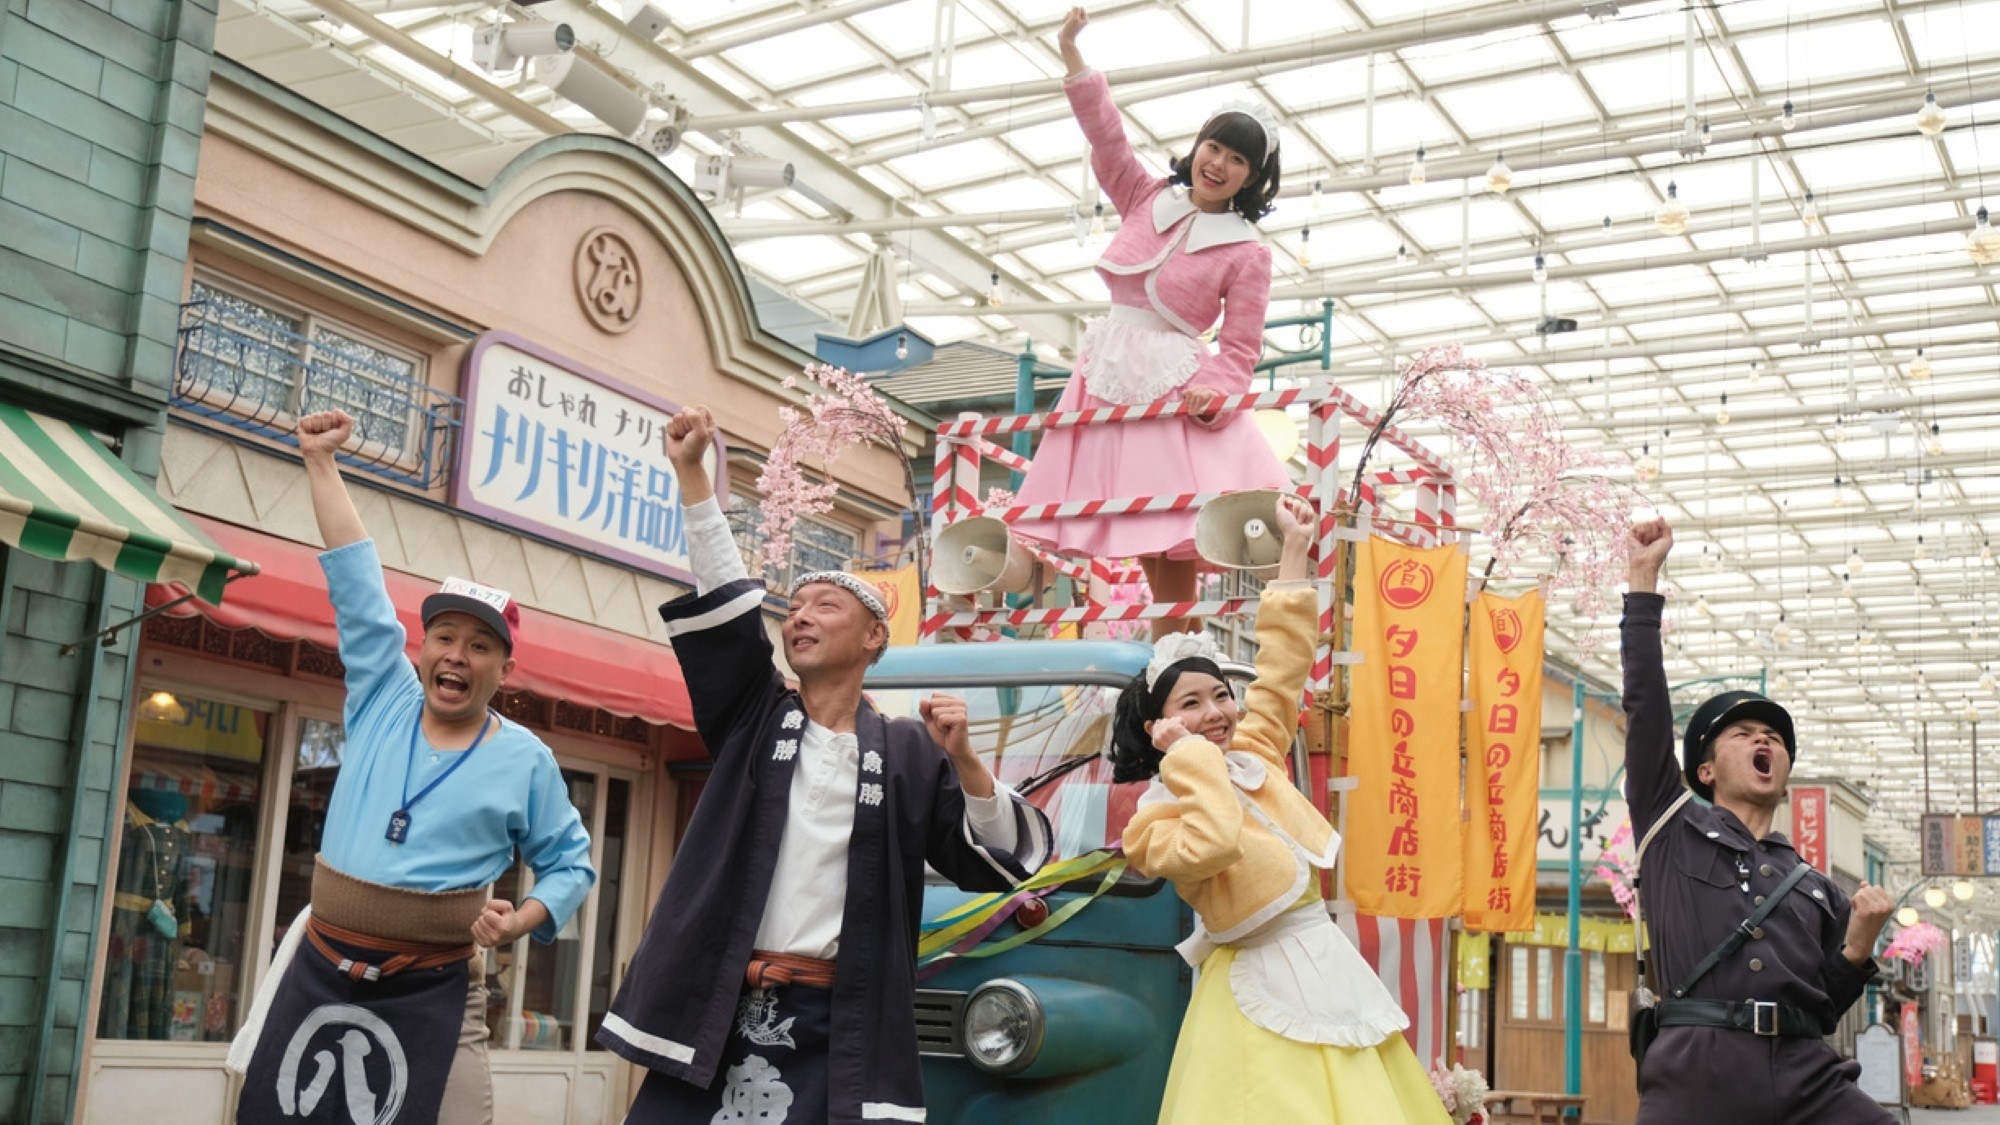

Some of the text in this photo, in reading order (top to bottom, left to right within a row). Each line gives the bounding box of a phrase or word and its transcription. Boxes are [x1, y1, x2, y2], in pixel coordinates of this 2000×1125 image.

[507, 364, 599, 429] おしゃれ
[1384, 623, 1422, 897] 夕日の丘商店街
[1485, 667, 1521, 914] 夕日の丘商店街
